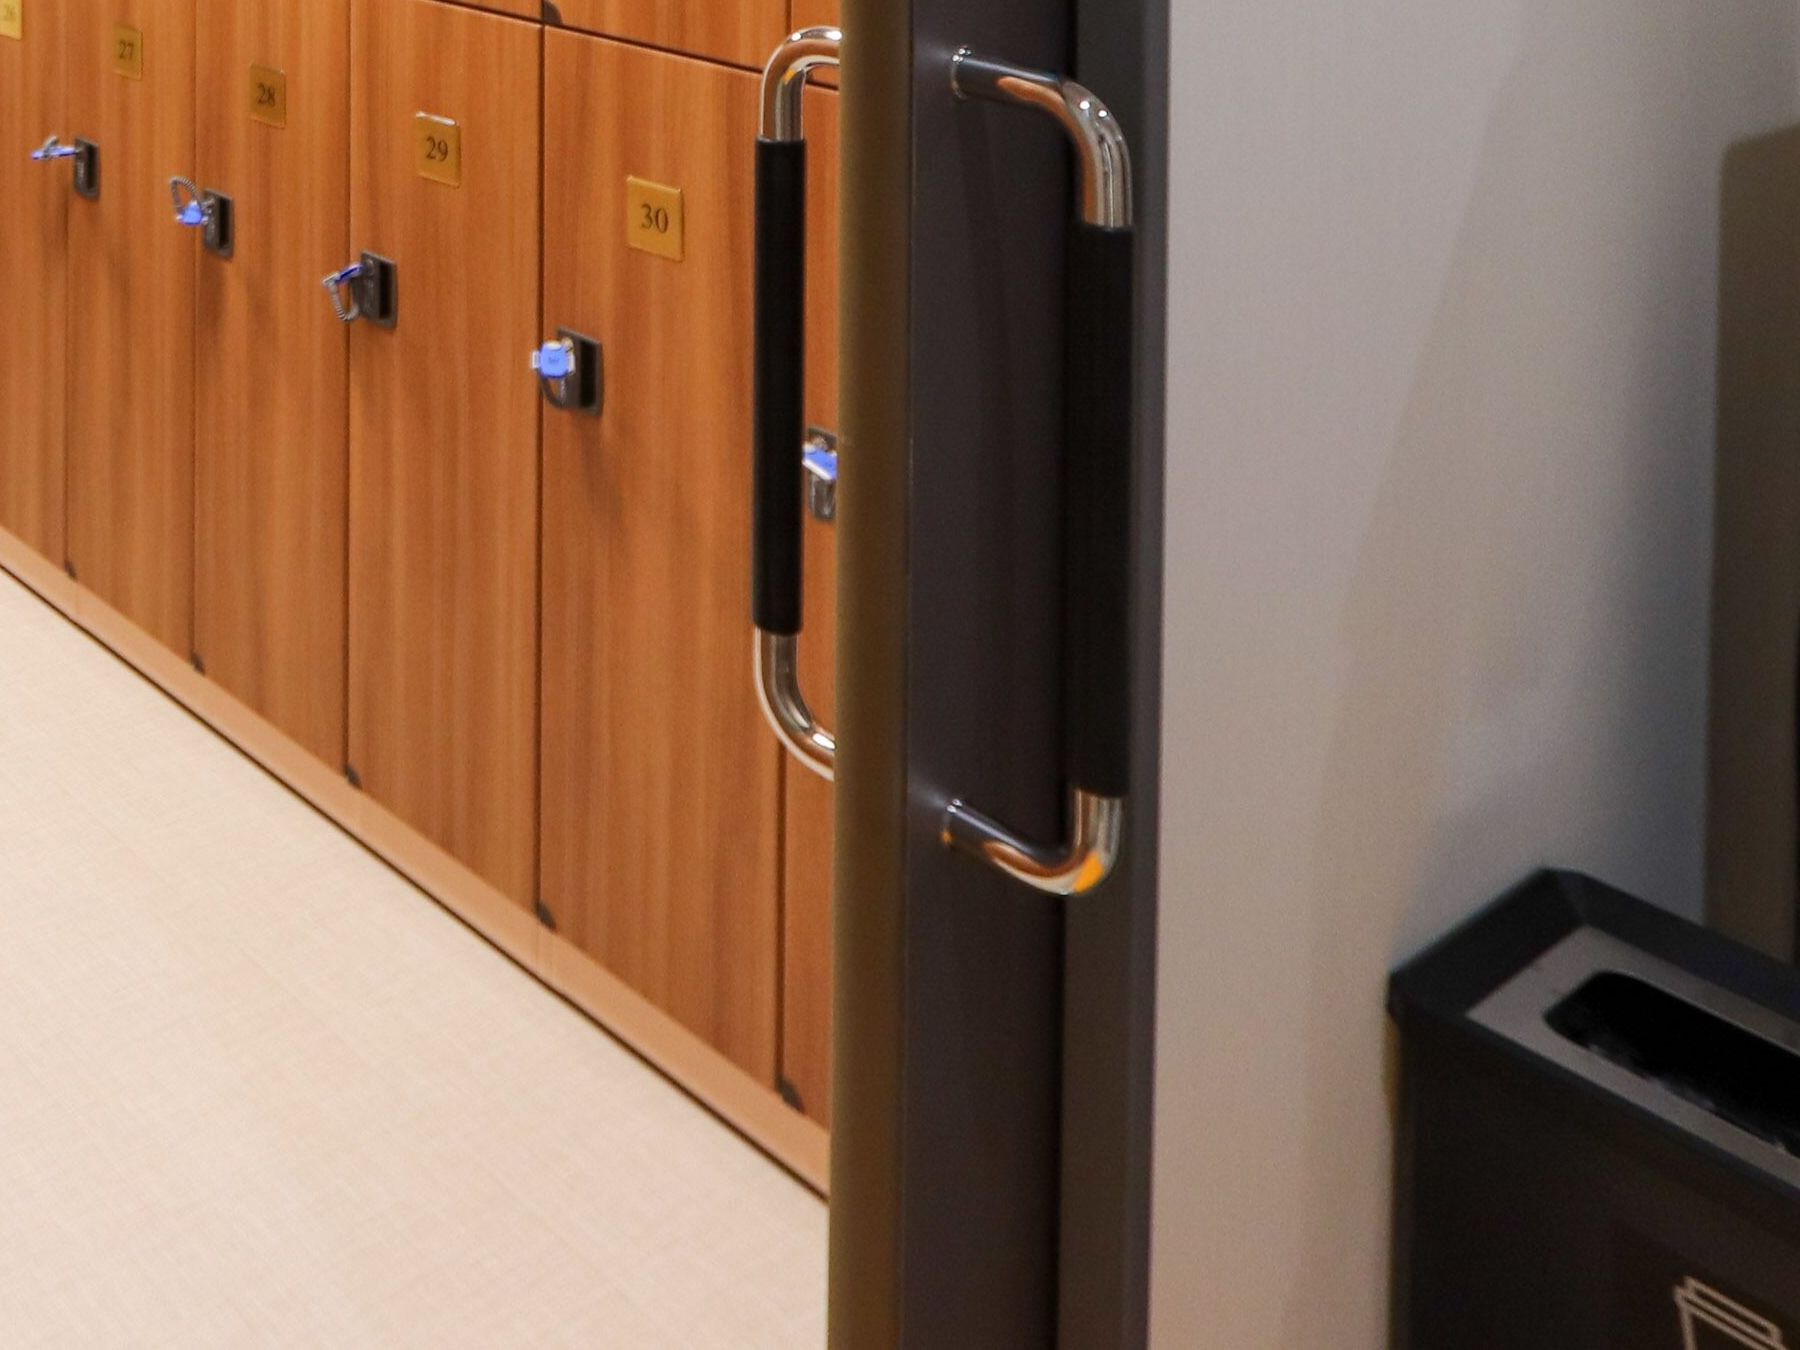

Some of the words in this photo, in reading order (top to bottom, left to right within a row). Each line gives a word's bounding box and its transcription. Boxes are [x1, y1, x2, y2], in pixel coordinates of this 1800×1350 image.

[118, 39, 135, 60] 27
[256, 82, 276, 108] 28
[425, 135, 449, 162] 29
[641, 202, 669, 234] 30
